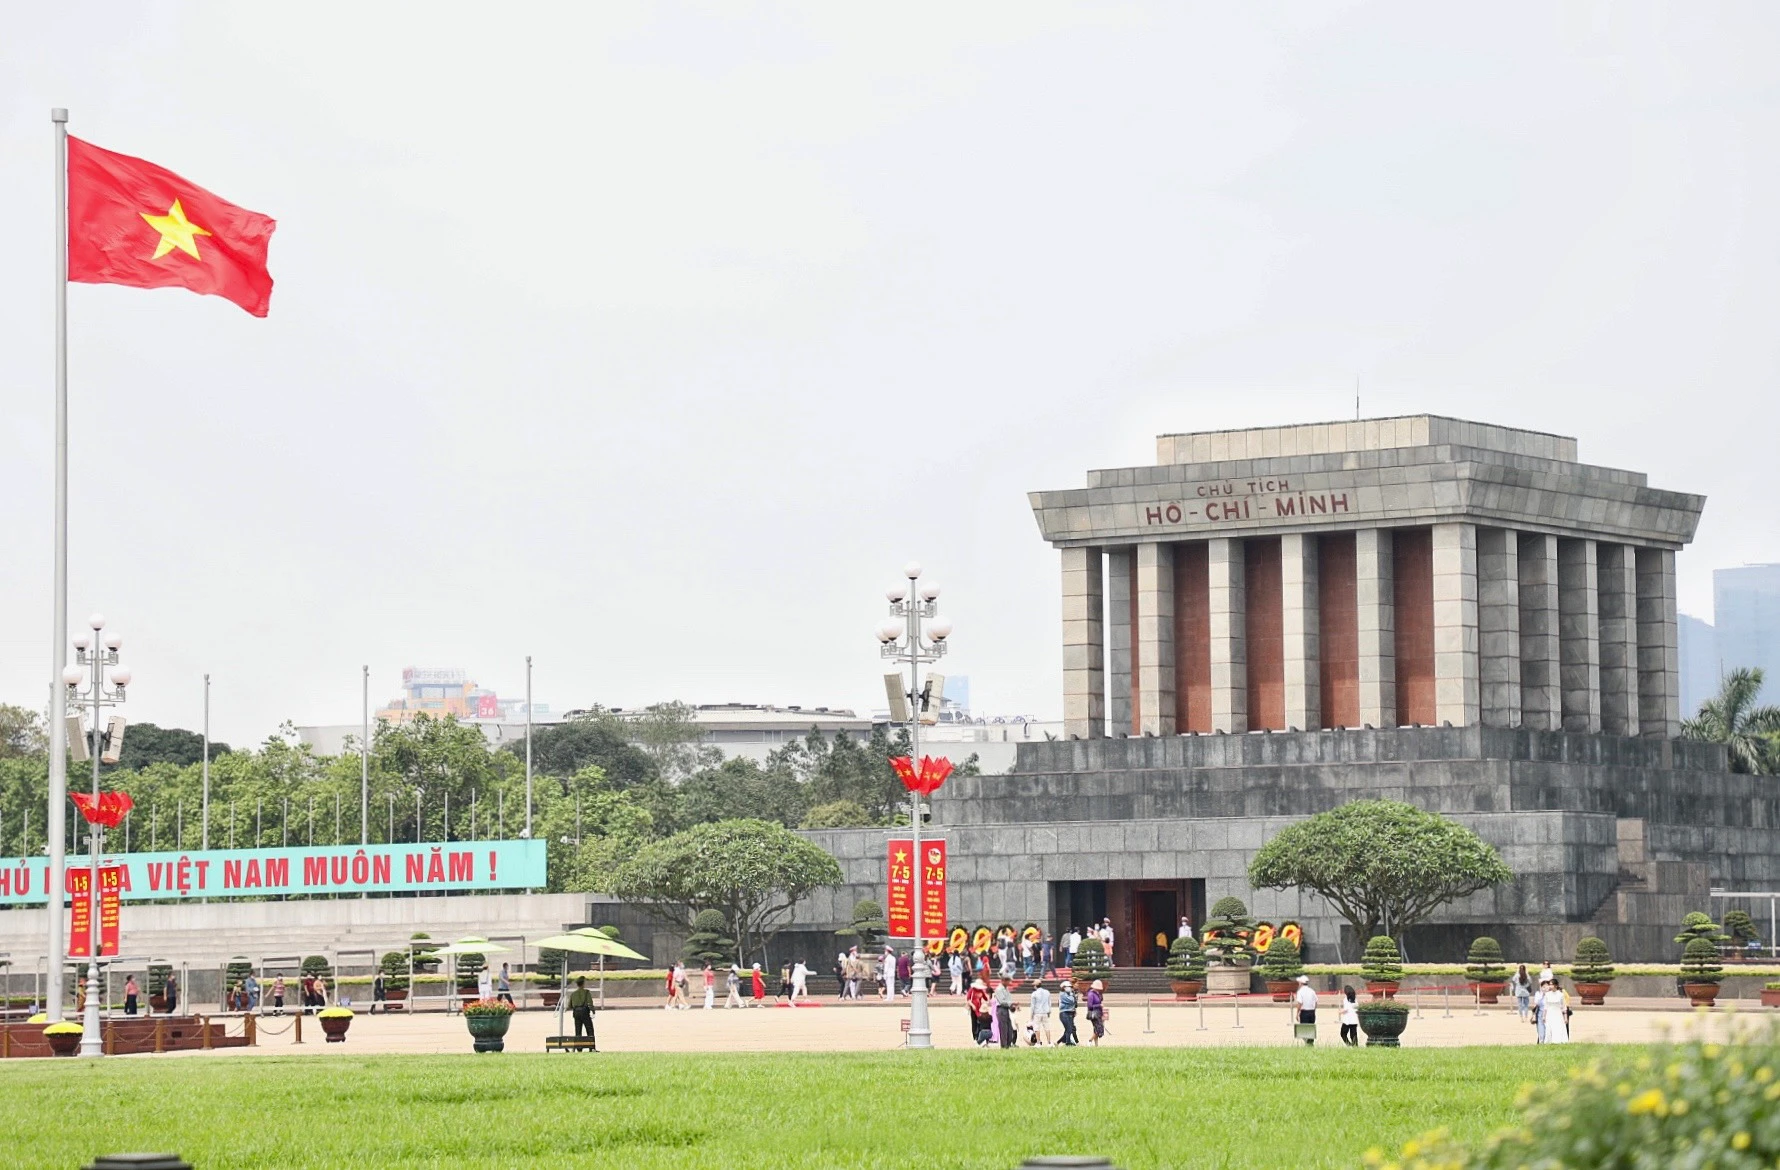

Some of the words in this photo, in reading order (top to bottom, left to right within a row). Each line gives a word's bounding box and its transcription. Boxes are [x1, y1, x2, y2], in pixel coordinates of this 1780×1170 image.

[1197, 479, 1232, 497] CHỦ
[1205, 495, 1250, 520] CHÍ
[147, 855, 210, 895] VIỆT
[224, 858, 289, 889] NAM
[304, 849, 391, 886] MUÔN
[405, 847, 473, 884] NĂM
